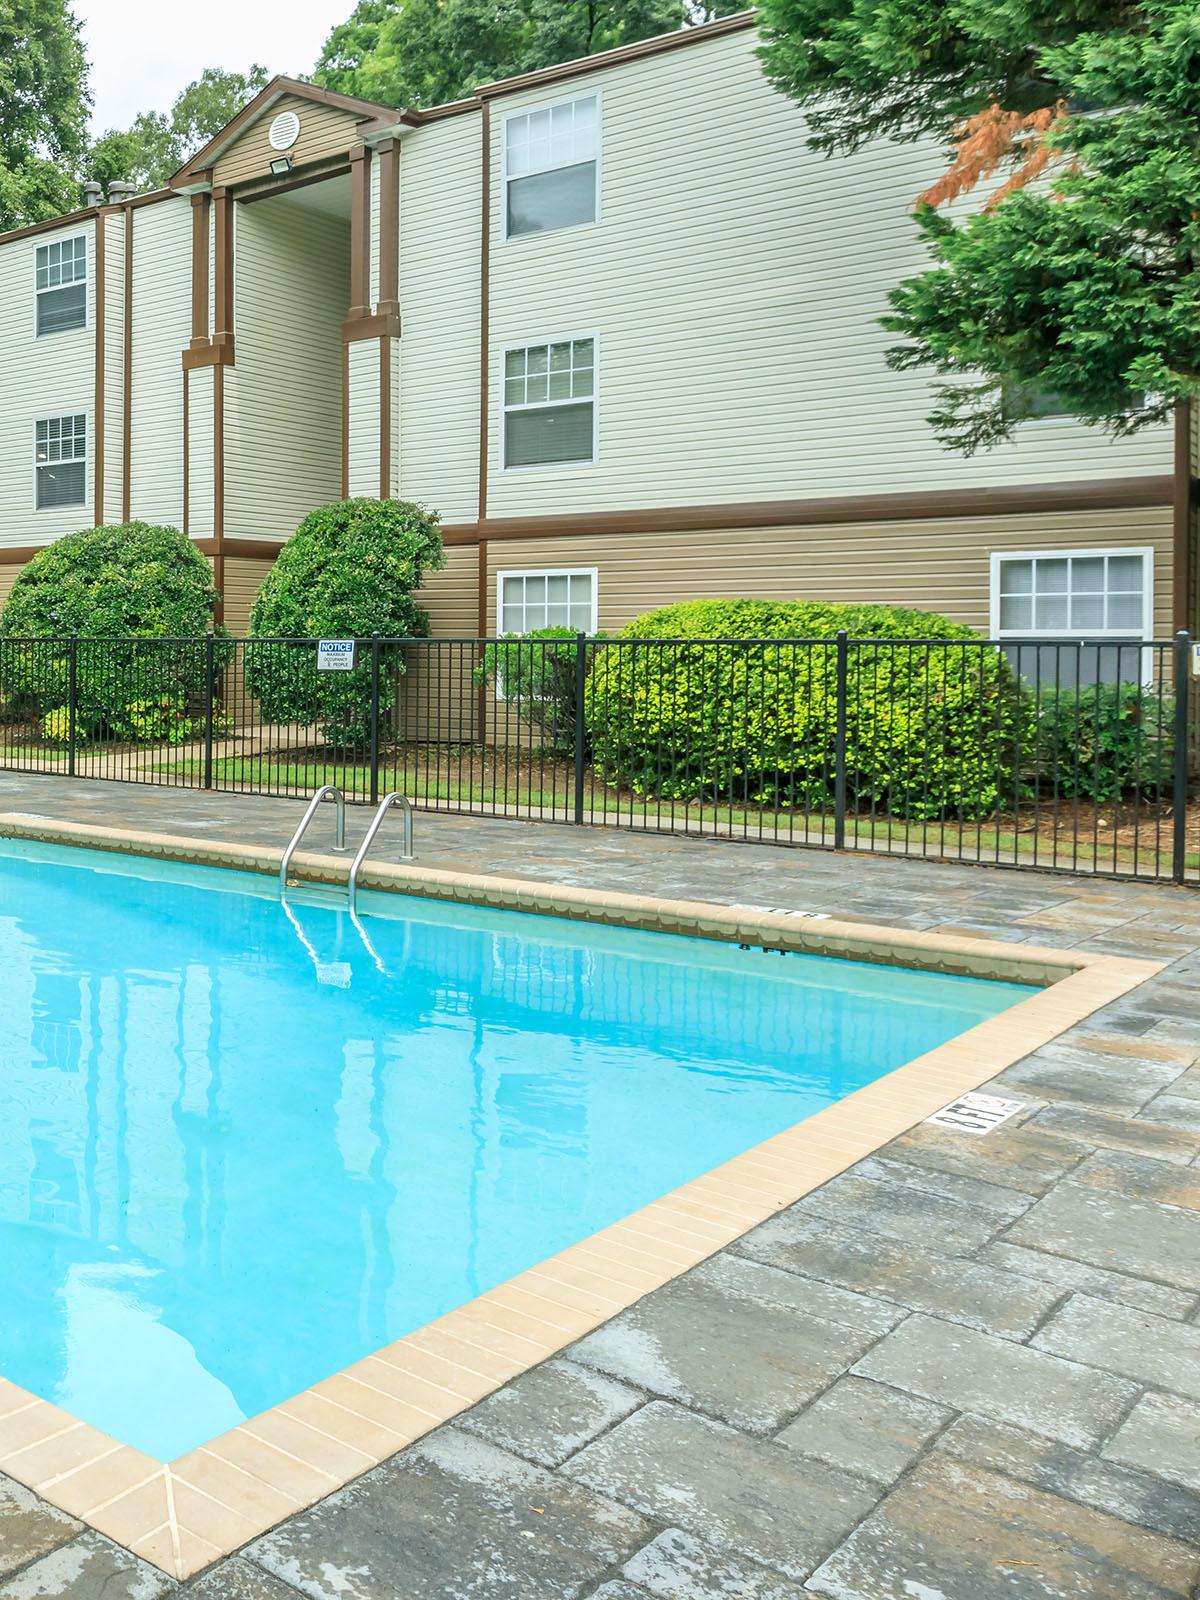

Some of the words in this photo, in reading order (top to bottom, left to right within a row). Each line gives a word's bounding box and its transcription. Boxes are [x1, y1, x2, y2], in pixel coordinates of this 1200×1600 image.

[321, 643, 351, 651] NOTICE
[945, 1103, 1005, 1122] FT
[935, 1116, 987, 1129] 8
